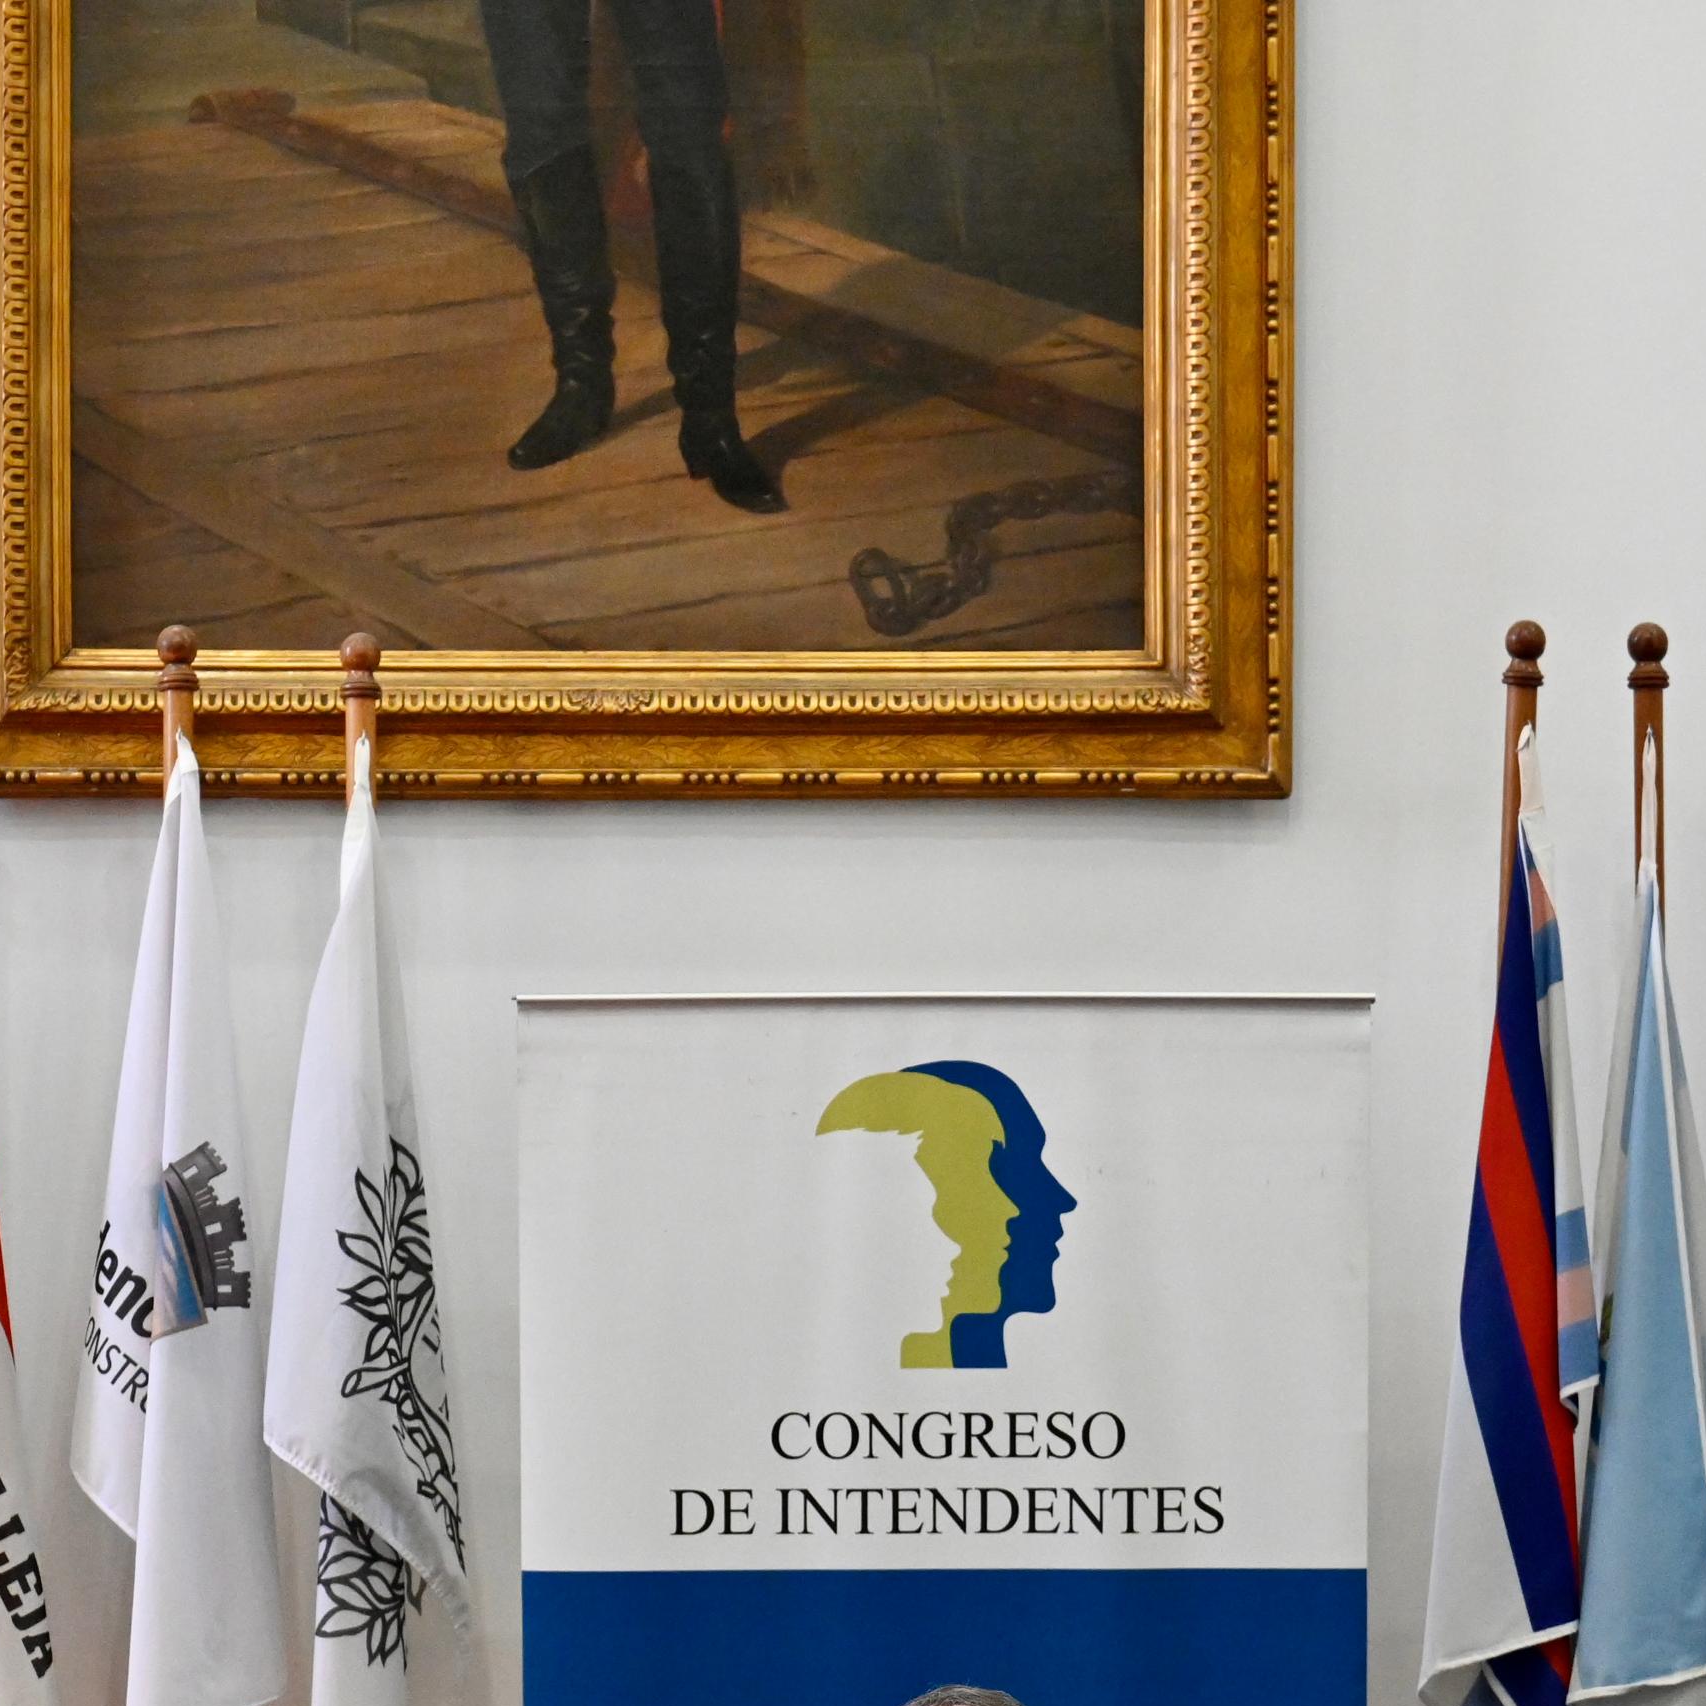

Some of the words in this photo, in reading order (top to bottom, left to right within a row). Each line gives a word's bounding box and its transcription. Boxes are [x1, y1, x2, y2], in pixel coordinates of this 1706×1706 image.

[85, 1315, 150, 1415] ONSTR
[770, 1411, 1126, 1460] CONGRESO
[670, 1488, 756, 1536] DE
[775, 1486, 1225, 1535] INTENDENTES
